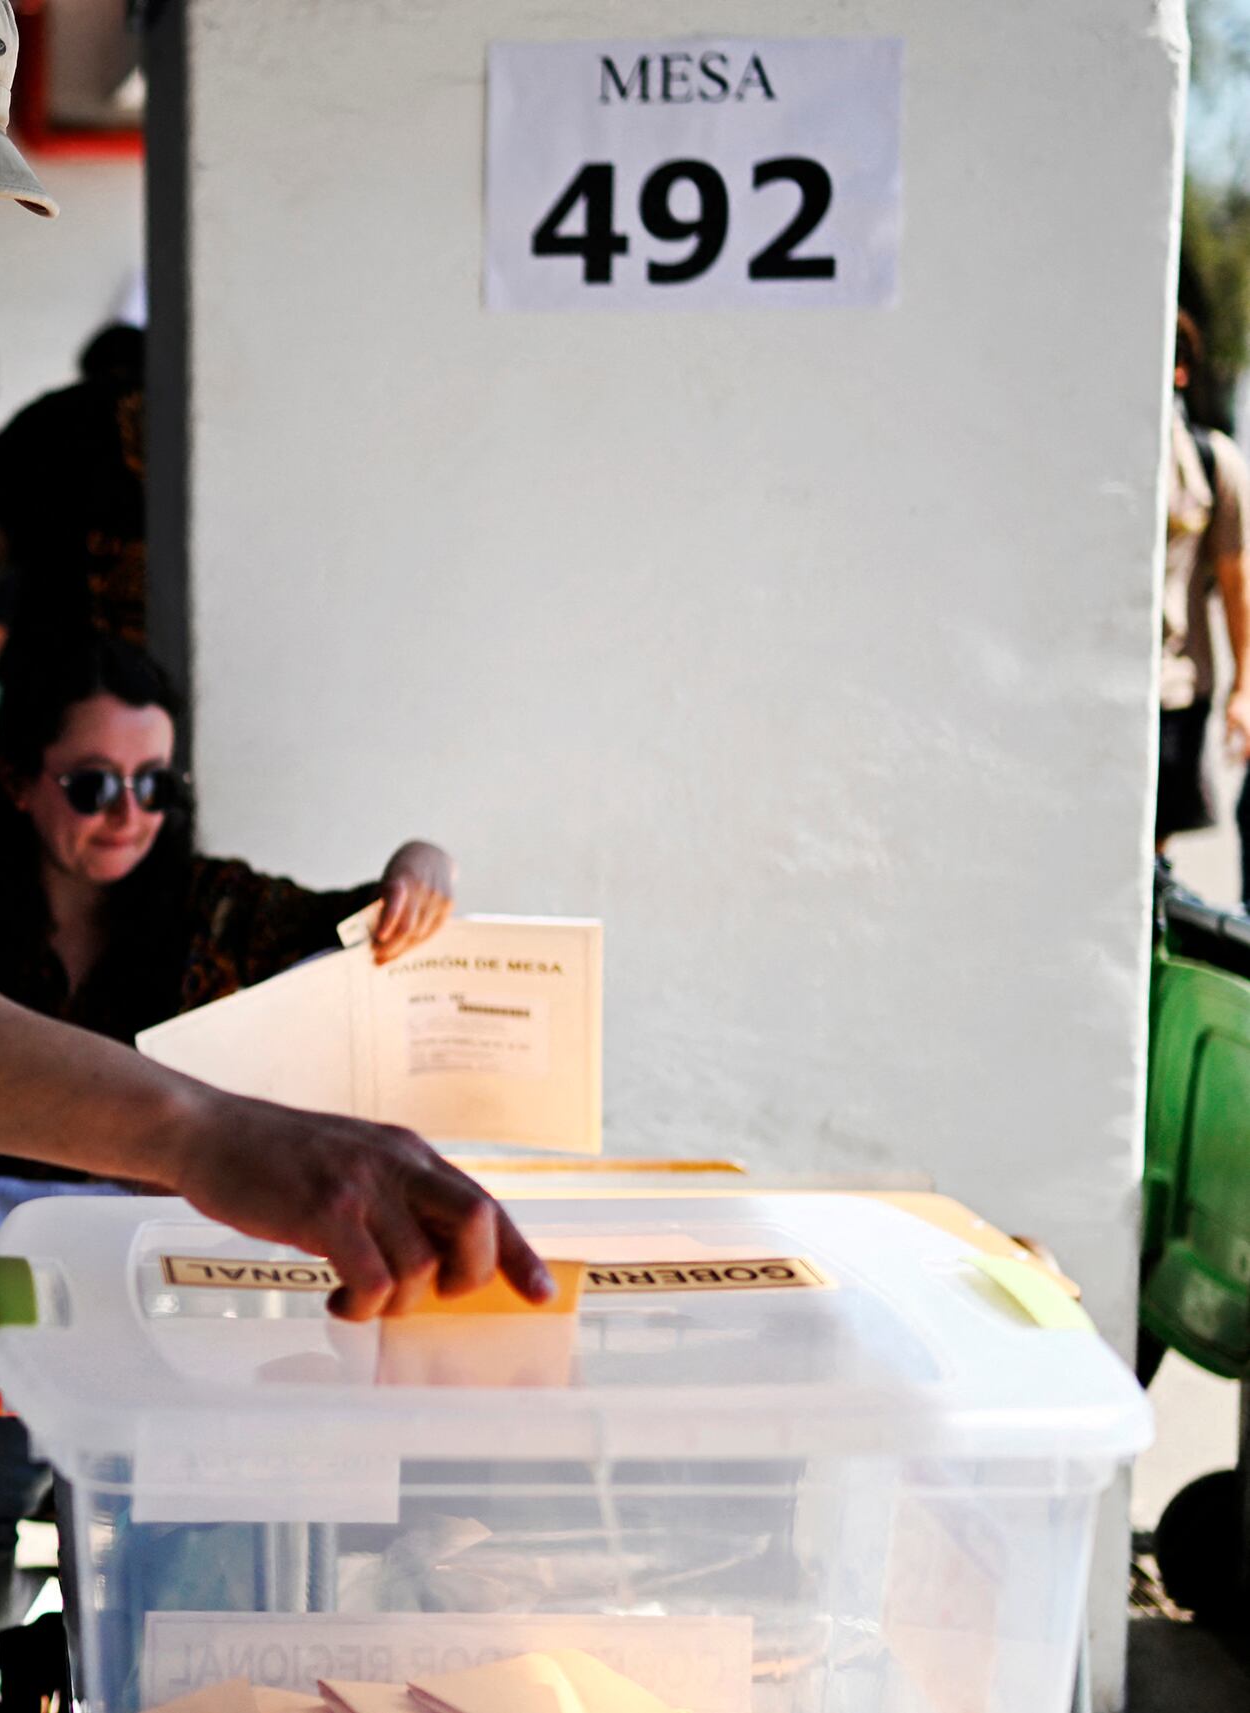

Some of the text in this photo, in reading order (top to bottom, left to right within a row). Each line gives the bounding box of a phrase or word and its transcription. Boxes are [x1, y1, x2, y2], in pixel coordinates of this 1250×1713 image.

[599, 52, 776, 103] MESA
[531, 156, 836, 285] 492
[474, 958, 499, 971] DE
[506, 959, 564, 975] MESA
[188, 1263, 795, 1285] GOBERN IONAL
